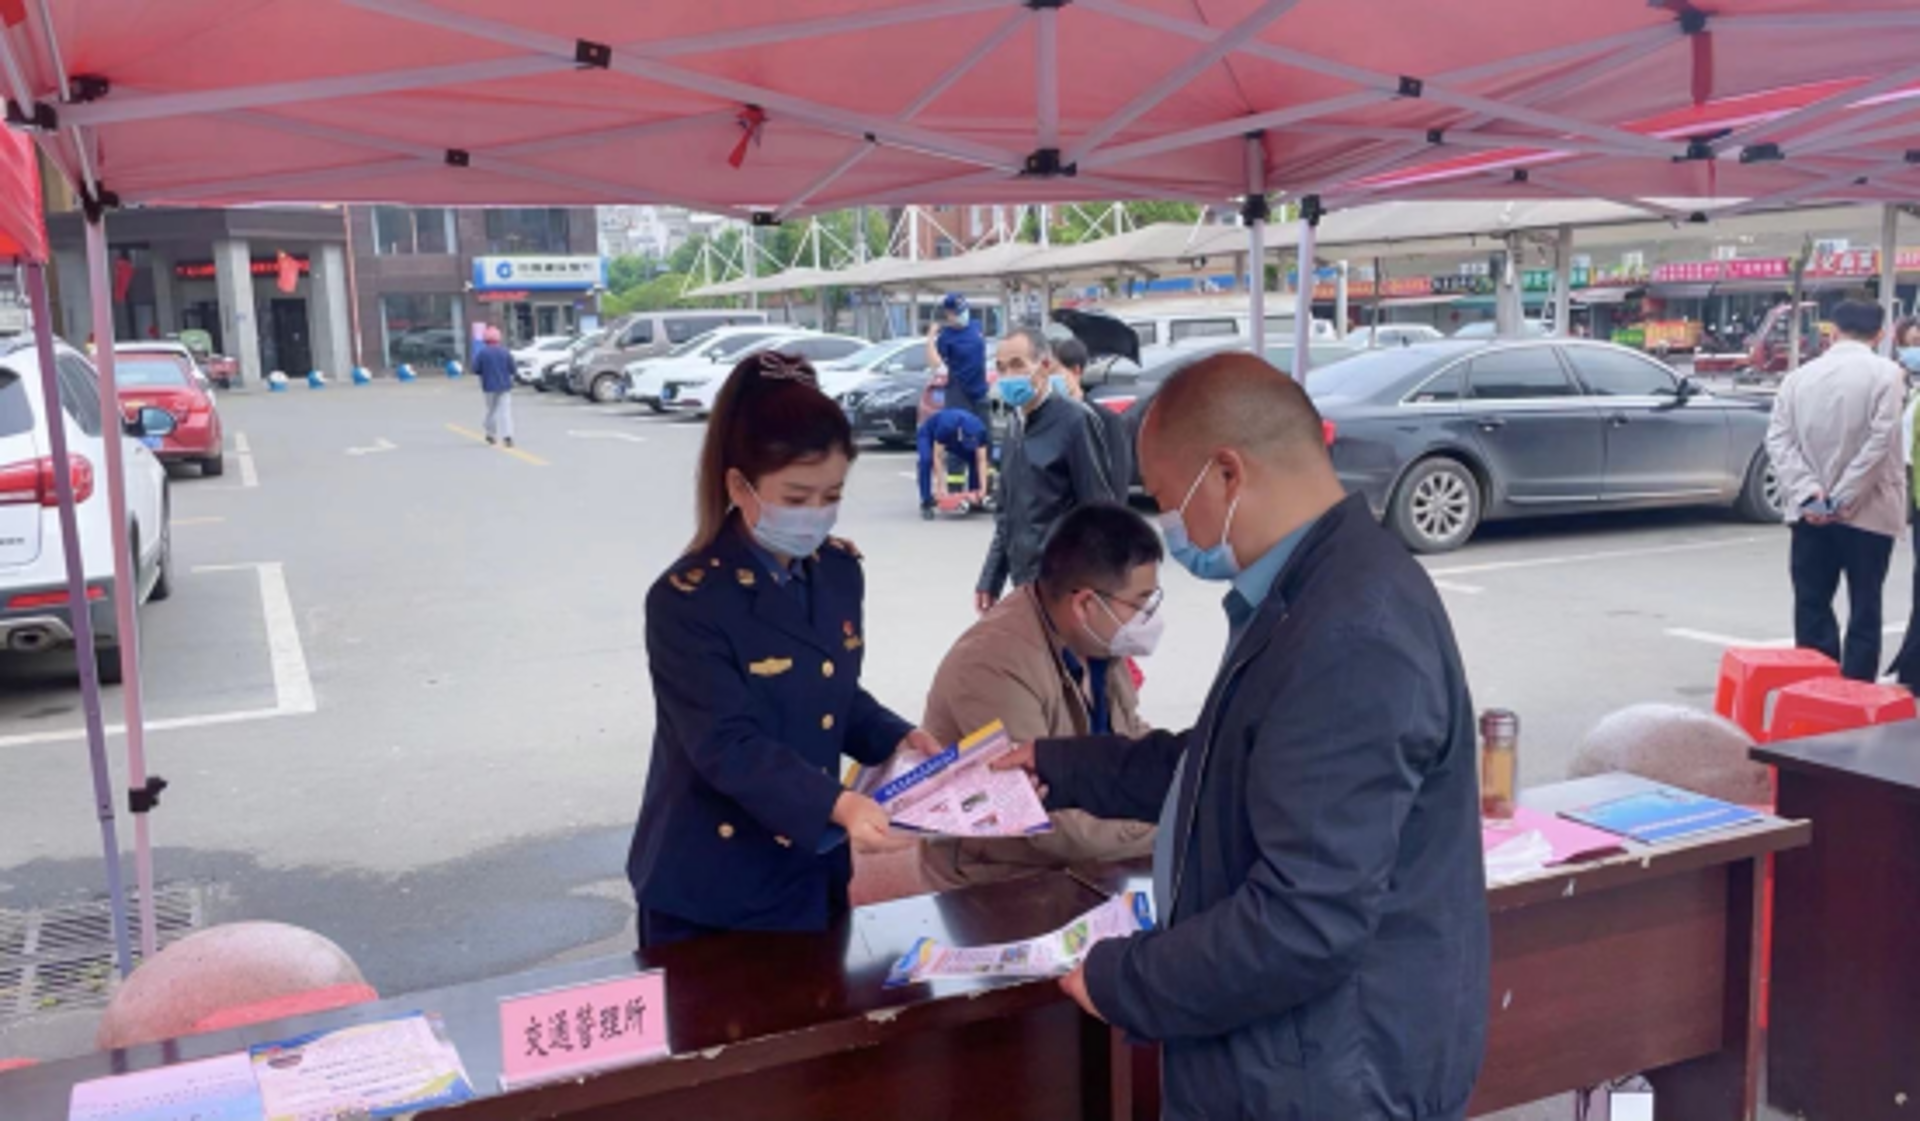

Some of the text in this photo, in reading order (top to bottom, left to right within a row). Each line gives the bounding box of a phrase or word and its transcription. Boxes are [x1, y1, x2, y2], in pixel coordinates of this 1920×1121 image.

[524, 996, 647, 1057] 交通管理所
